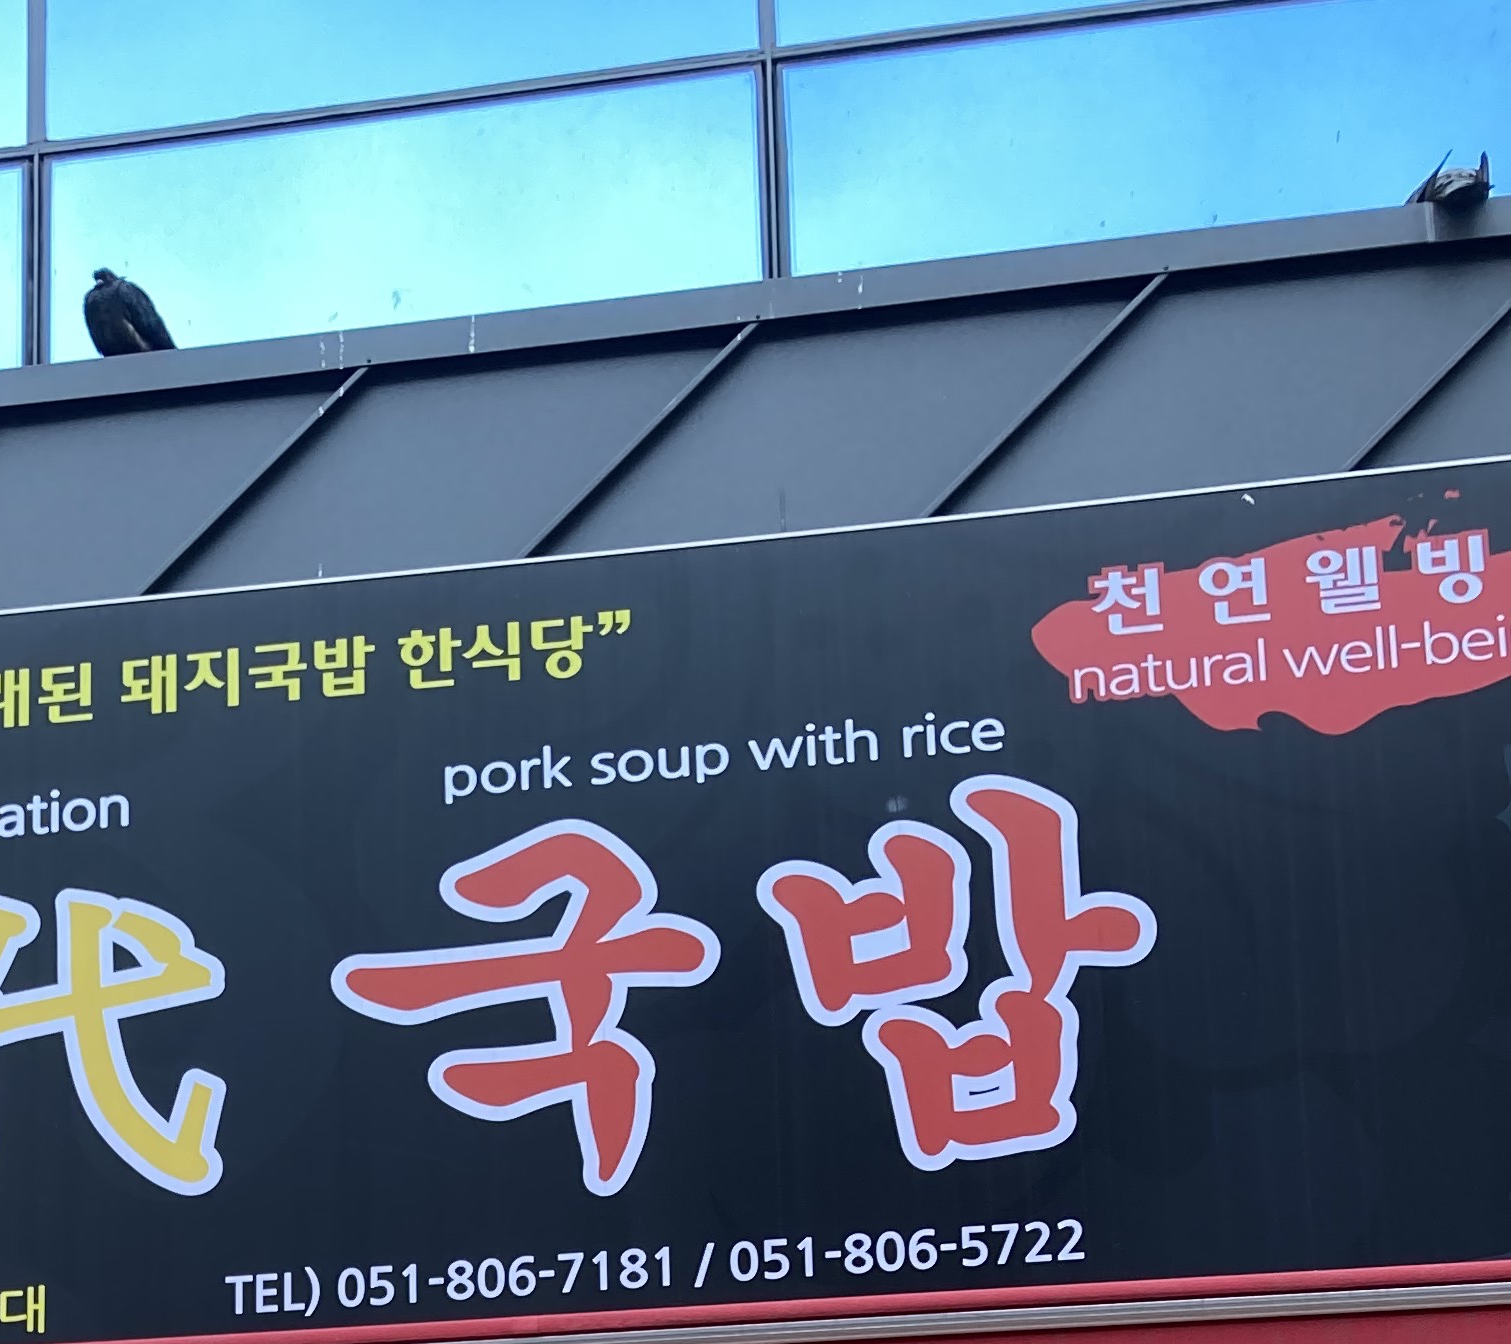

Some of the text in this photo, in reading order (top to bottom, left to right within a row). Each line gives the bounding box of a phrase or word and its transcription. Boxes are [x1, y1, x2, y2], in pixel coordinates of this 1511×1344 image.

[120, 635, 376, 717] 돼지국밥
[396, 610, 632, 688] 한식당”
[1072, 638, 1268, 701] natural
[444, 711, 1005, 804] pork soup with rice
[225, 1266, 321, 1317] TEL)
[337, 1246, 671, 1309] 051-806-7181
[729, 1218, 1086, 1282] 051-806-5722
